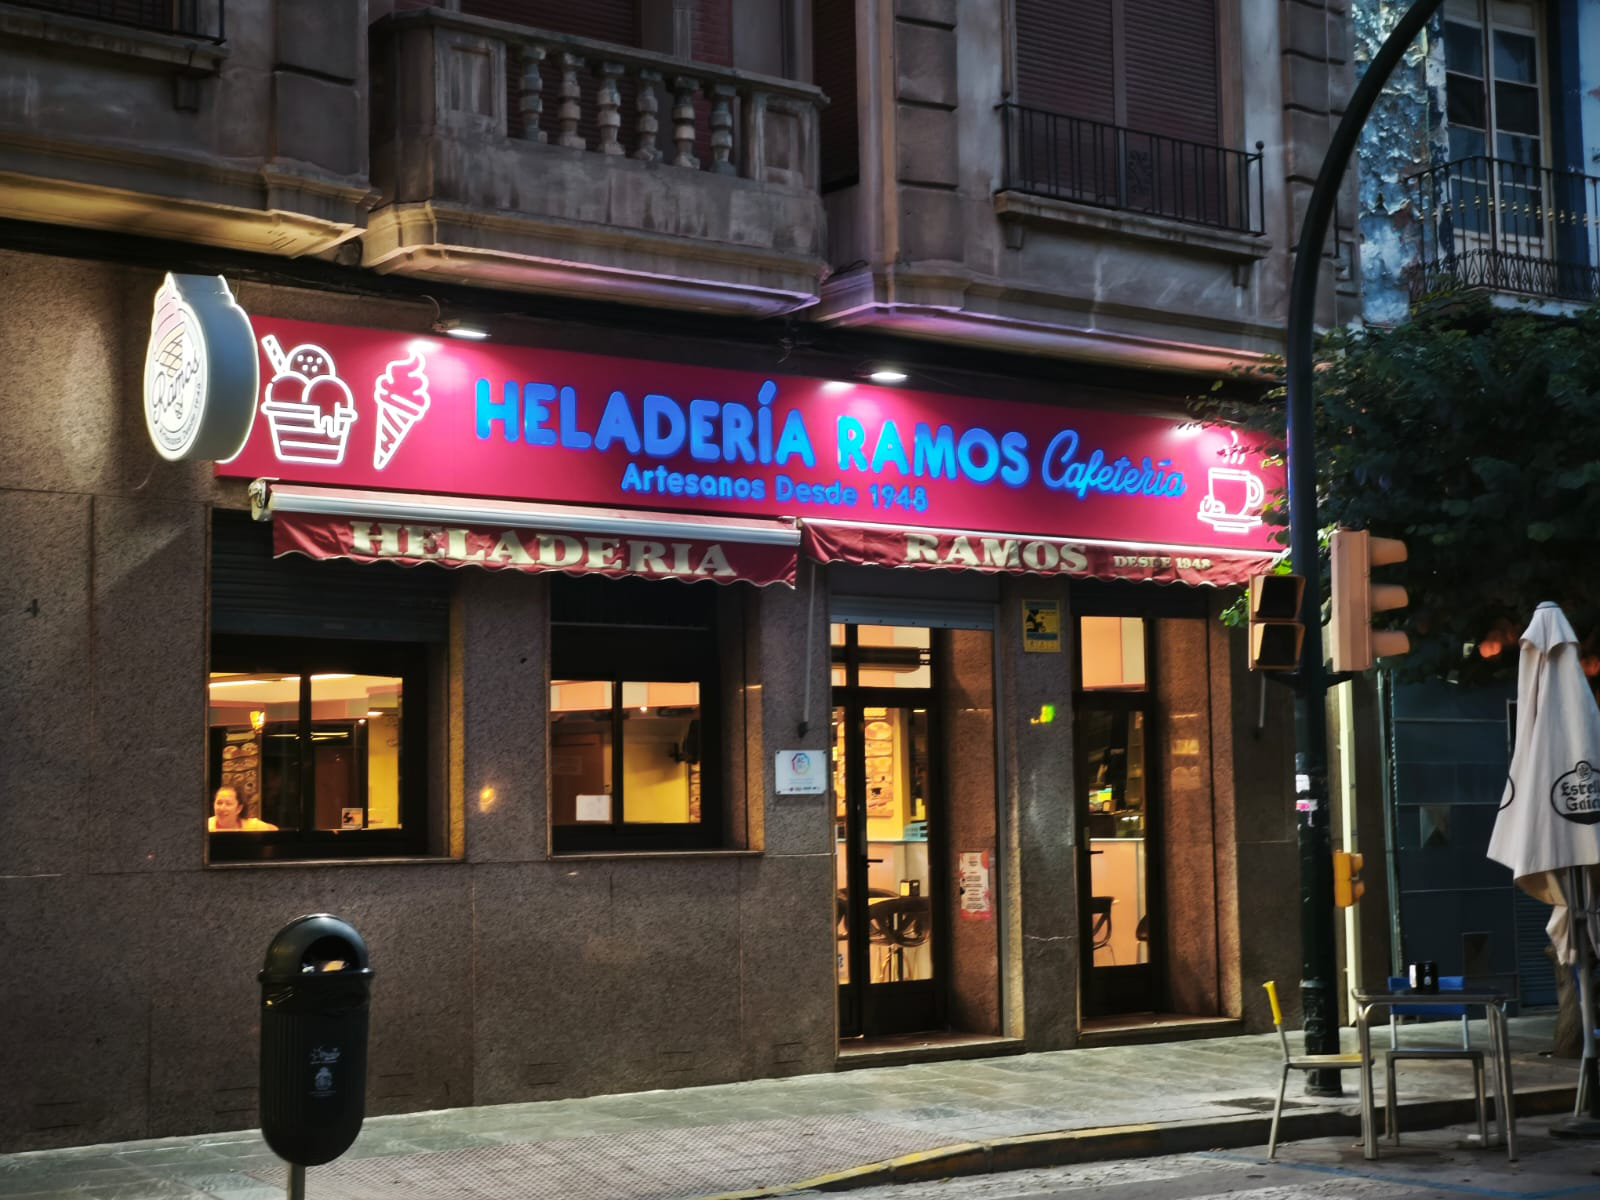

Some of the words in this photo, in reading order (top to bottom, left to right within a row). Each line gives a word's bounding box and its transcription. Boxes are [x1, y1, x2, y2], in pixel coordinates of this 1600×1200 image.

[475, 378, 816, 468] HELADERÍA
[836, 415, 1030, 486] RAMOS
[1041, 429, 1188, 498] Cafetería
[620, 461, 766, 500] Artesanos
[775, 474, 859, 508] Desde
[869, 483, 929, 513] 1948
[349, 520, 737, 577] HELADERIA
[902, 533, 1089, 572] RAMOS
